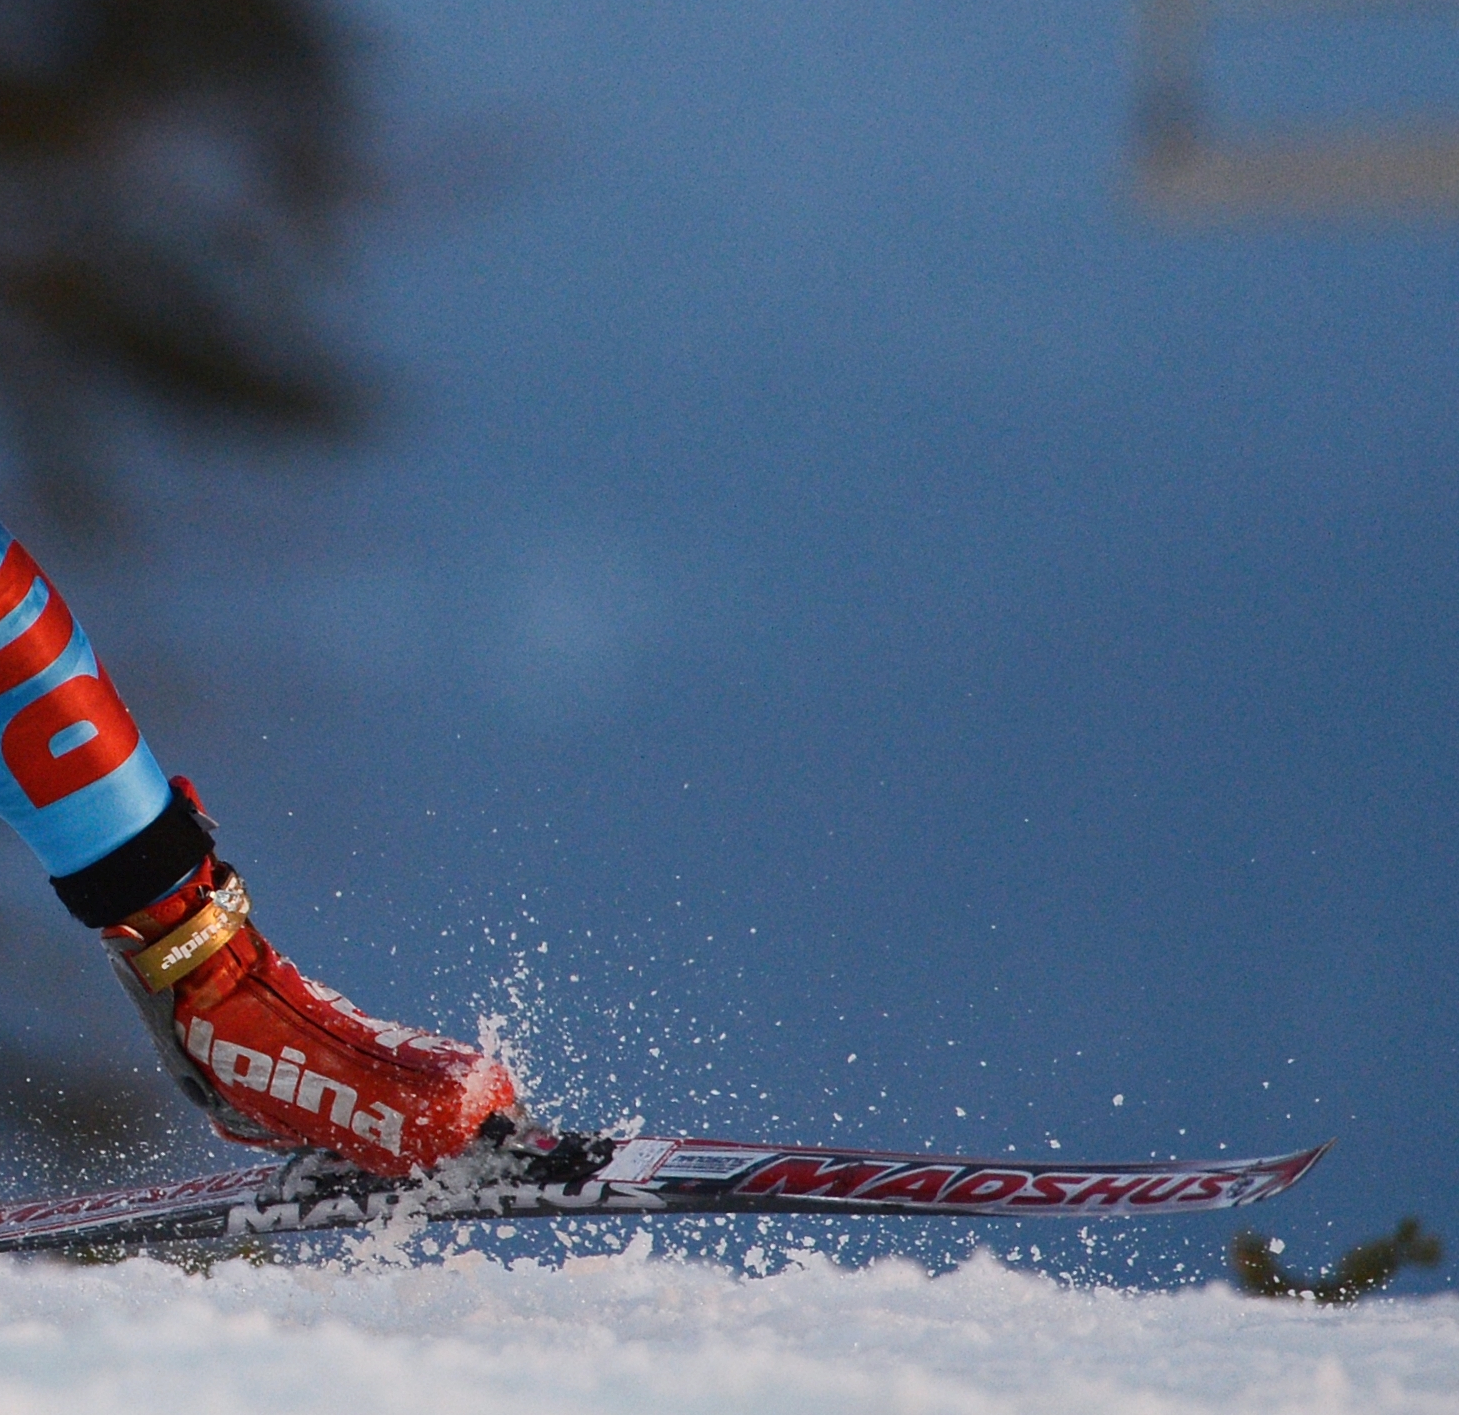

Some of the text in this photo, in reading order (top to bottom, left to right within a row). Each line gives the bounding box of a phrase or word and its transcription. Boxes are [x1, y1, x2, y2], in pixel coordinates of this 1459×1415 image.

[161, 912, 229, 971] alpina
[175, 1016, 407, 1158] lpina
[734, 1155, 1241, 1206] MADSHUS
